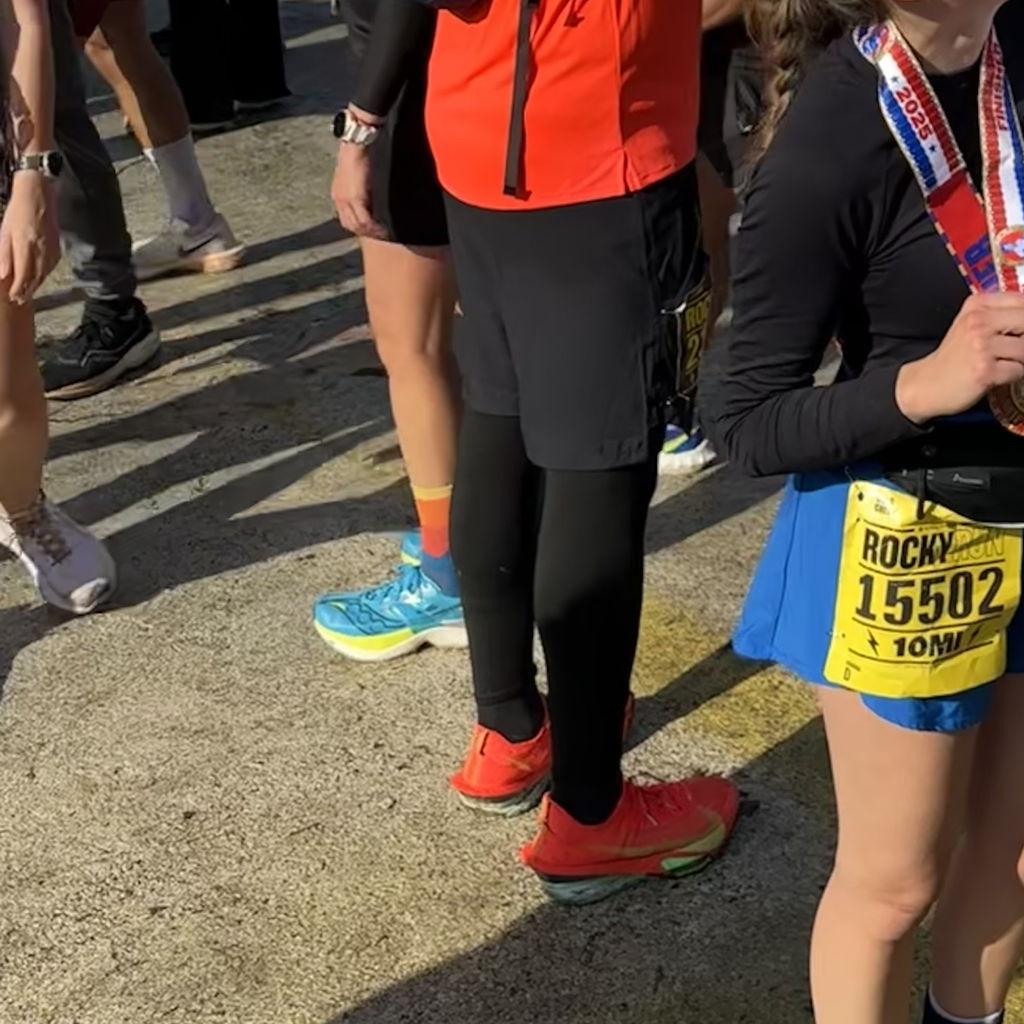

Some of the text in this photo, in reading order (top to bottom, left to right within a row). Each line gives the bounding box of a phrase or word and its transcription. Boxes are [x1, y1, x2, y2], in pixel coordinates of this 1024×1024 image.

[895, 86, 934, 141] 2025
[855, 567, 1005, 625] 15502
[892, 631, 964, 658] 10MI
